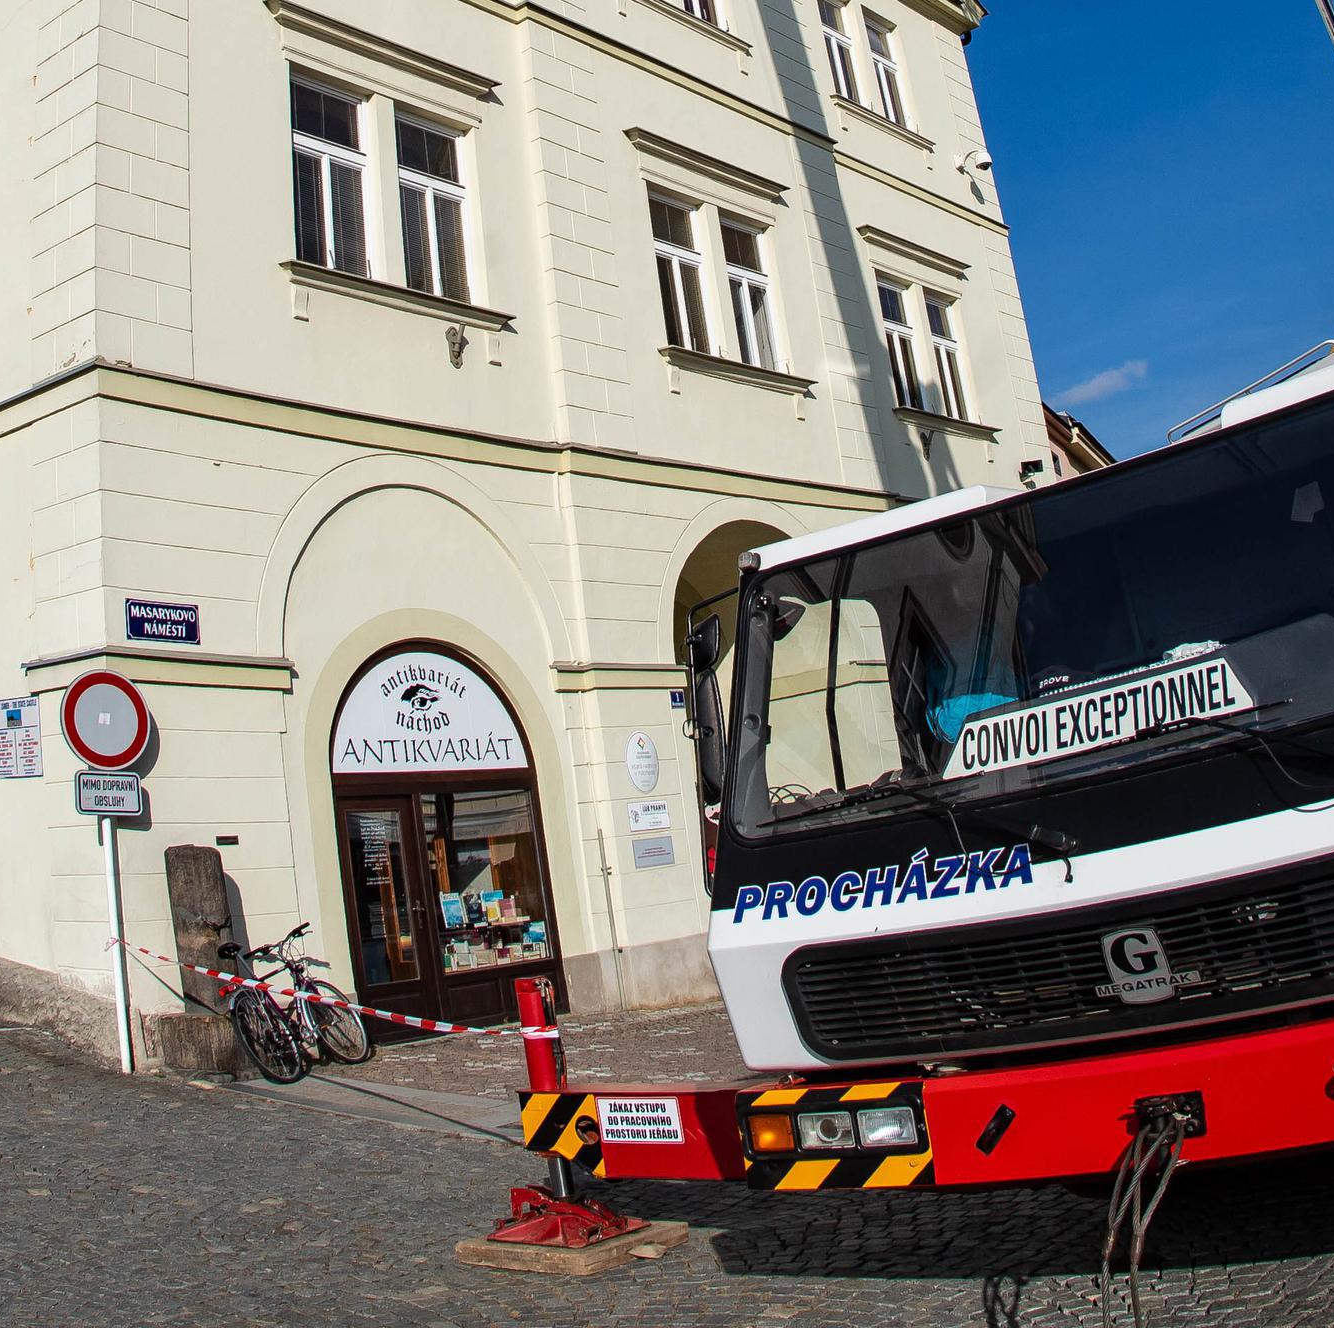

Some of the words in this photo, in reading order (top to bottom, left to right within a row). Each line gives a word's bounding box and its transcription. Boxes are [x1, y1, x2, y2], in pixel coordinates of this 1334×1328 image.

[130, 605, 196, 623] MASARYKOVO
[144, 620, 186, 638] NÁMĚSTÍ
[380, 665, 468, 699] antikvariát
[396, 710, 450, 735] náchod
[962, 712, 1048, 771] CONVOI
[1056, 664, 1236, 750] EXCEPTIONNEL
[341, 731, 513, 766] ANTIKVARIÁT
[82, 779, 101, 791] MIMO
[102, 778, 136, 793] DOPRAVNÍ
[94, 795, 125, 808] OBSLUHY
[733, 843, 1034, 924] PROCHÁZKA
[1110, 932, 1158, 975] G
[1097, 972, 1192, 997] MEGATRAK
[609, 1101, 633, 1113] ZÁKAZ
[634, 1102, 666, 1113] VSTUPU
[607, 1116, 618, 1126] DO
[620, 1114, 672, 1126] PRACOVNÍHO
[605, 1128, 647, 1140] PROSTORU
[648, 1127, 679, 1140] JEŘÁBU
